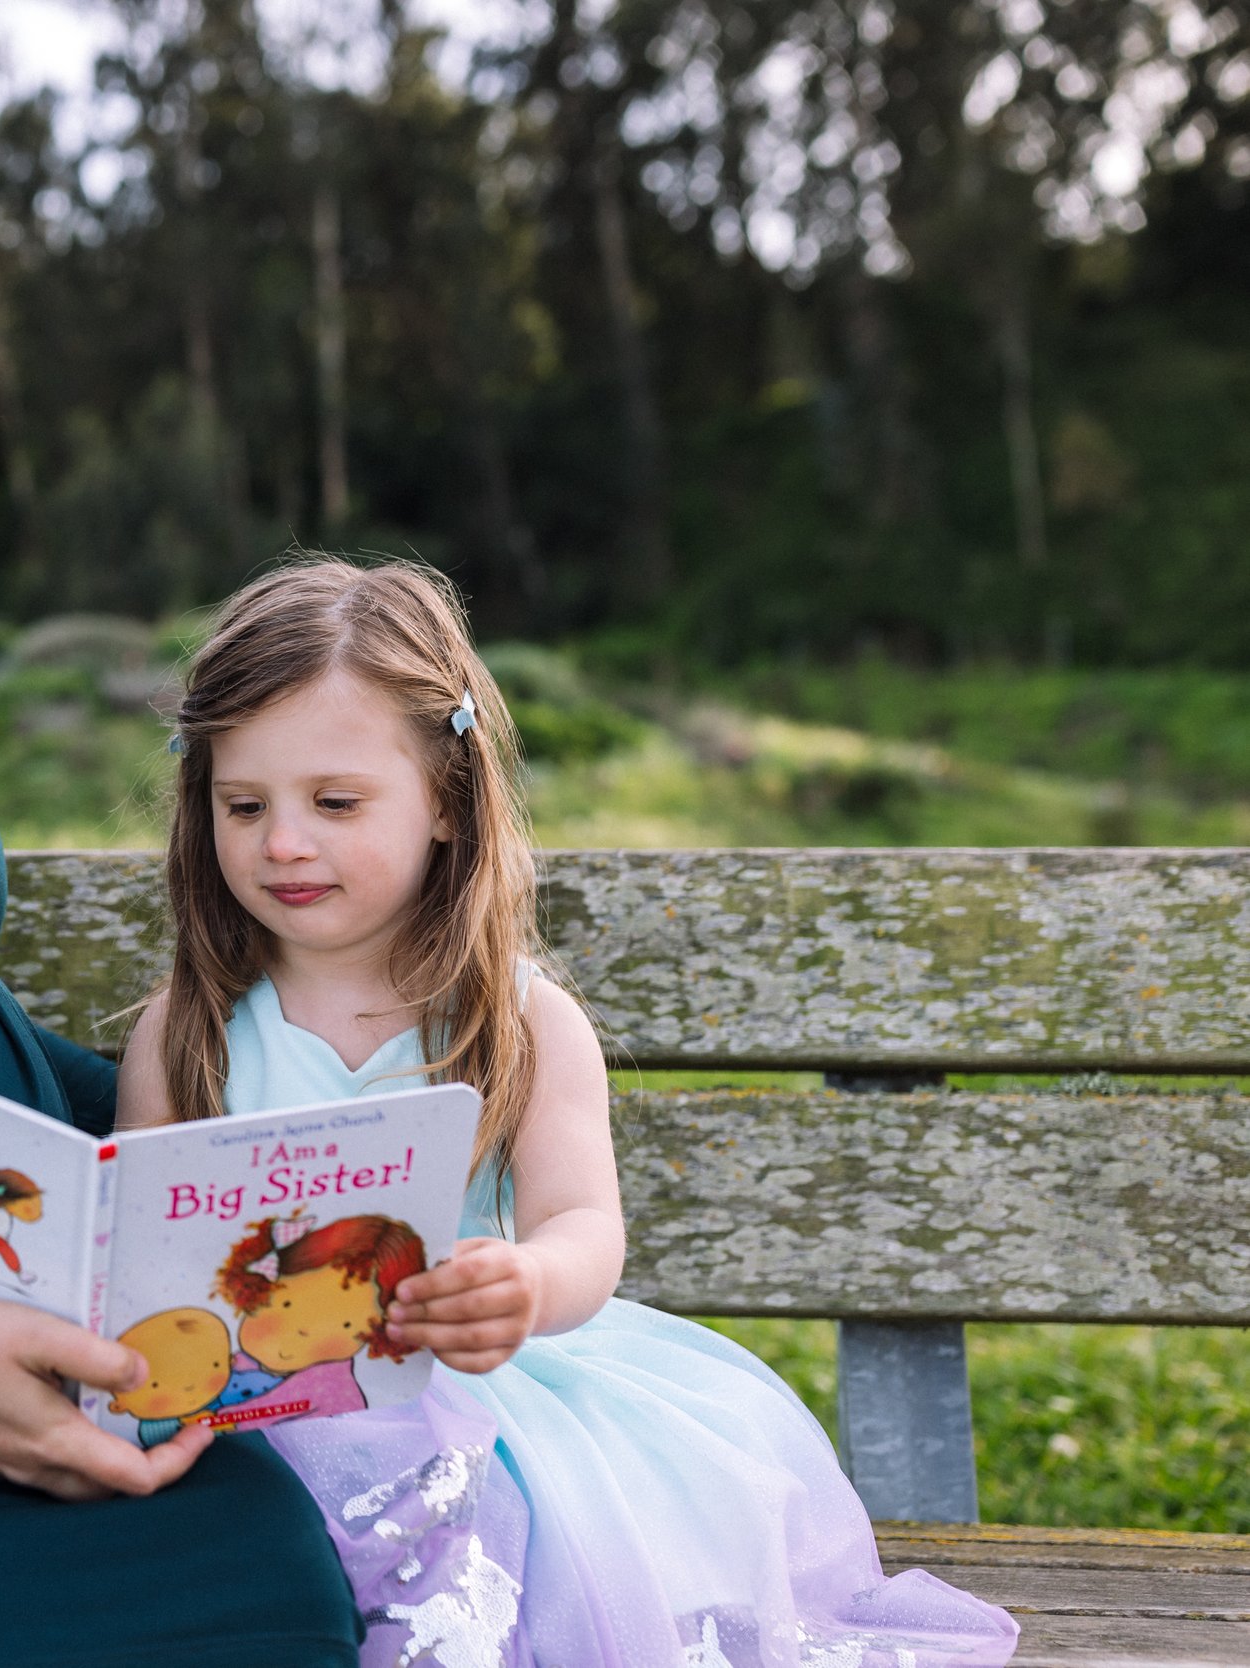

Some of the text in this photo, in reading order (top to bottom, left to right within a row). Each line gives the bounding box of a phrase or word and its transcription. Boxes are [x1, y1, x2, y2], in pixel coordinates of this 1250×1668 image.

[251, 1141, 339, 1168] I Am a
[165, 1183, 246, 1221] Big
[258, 1146, 415, 1206] Sister!
